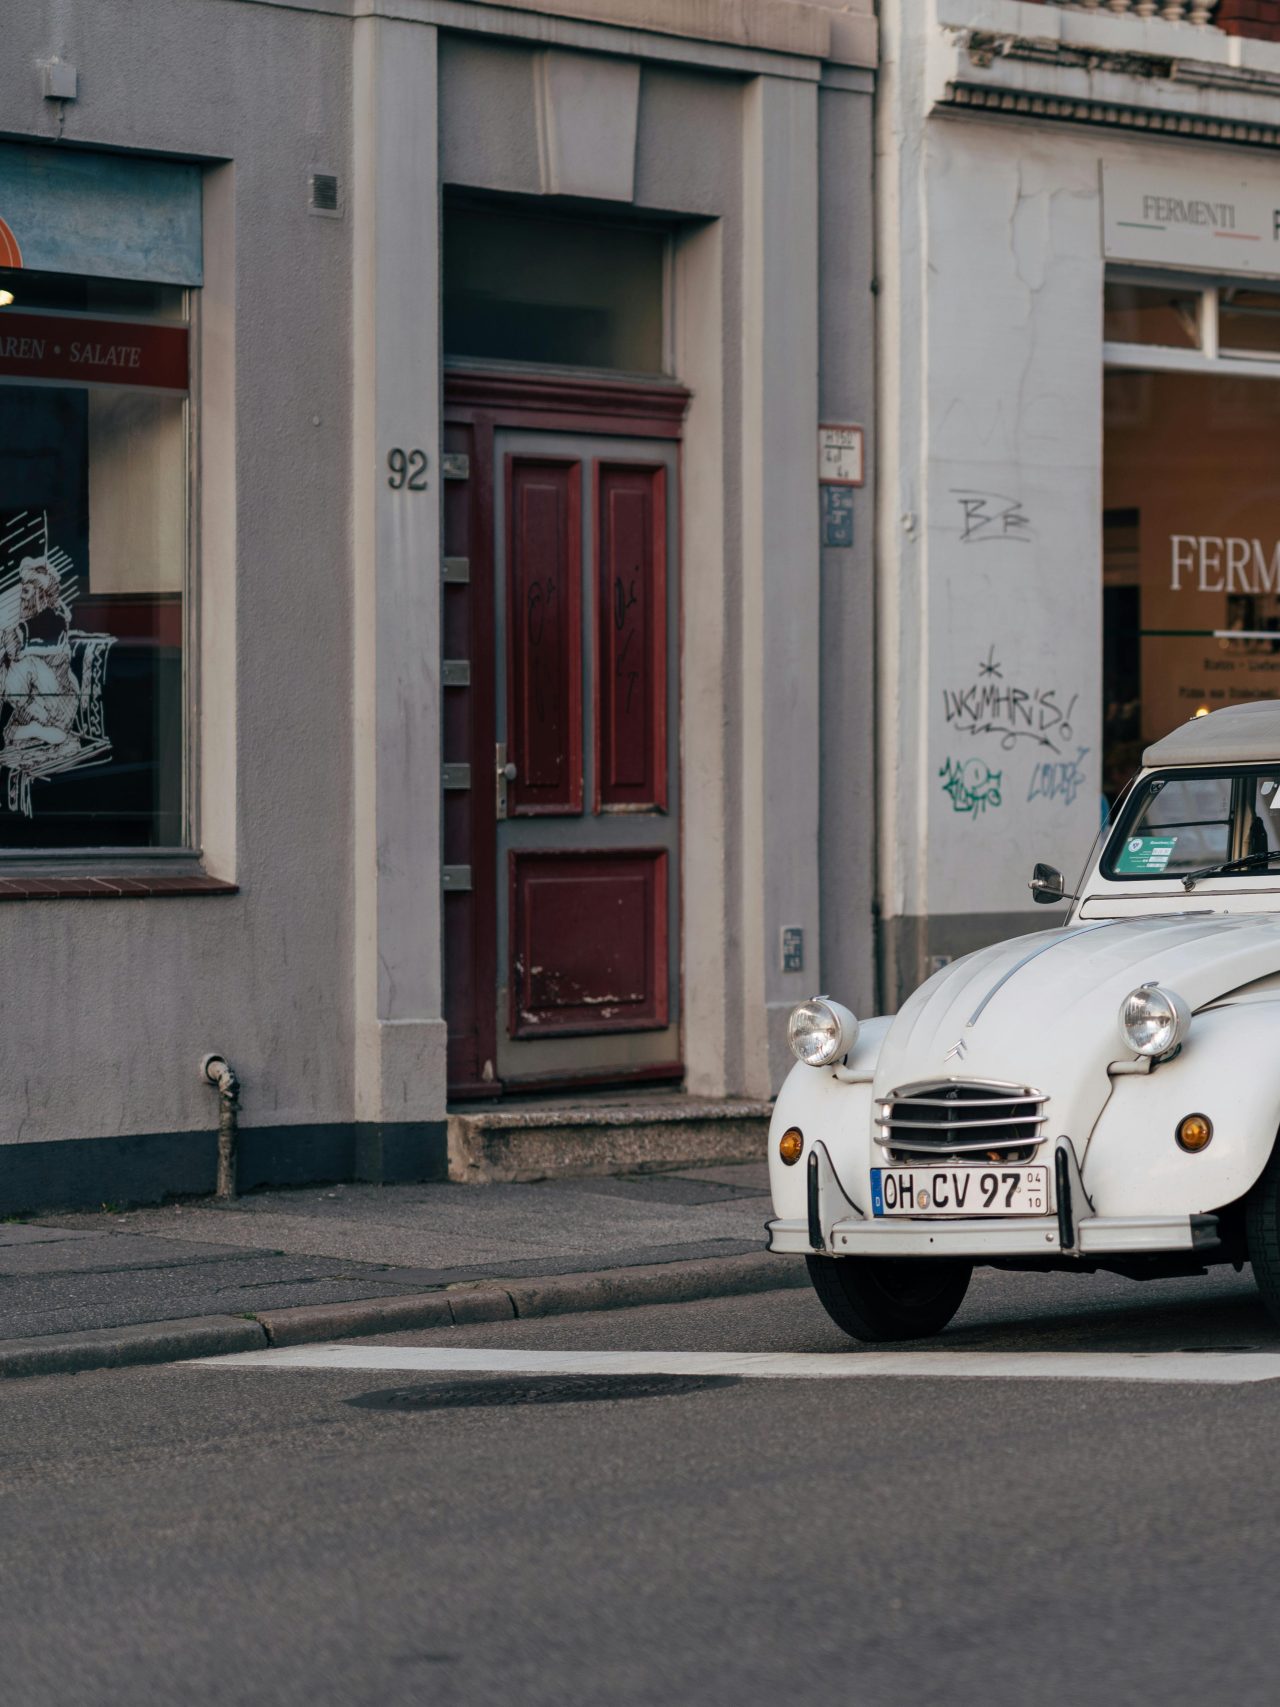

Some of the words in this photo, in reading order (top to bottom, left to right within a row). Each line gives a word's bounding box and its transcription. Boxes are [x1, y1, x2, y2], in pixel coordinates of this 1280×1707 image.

[1142, 195, 1236, 229] FERMENTI
[69, 341, 142, 368] SALATE
[387, 447, 428, 491] 92
[884, 1173, 914, 1209] OH
[932, 1173, 970, 1209] CV
[980, 1173, 1021, 1209] 97
[1027, 1172, 1041, 1183] 04
[1028, 1197, 1042, 1208] 10
